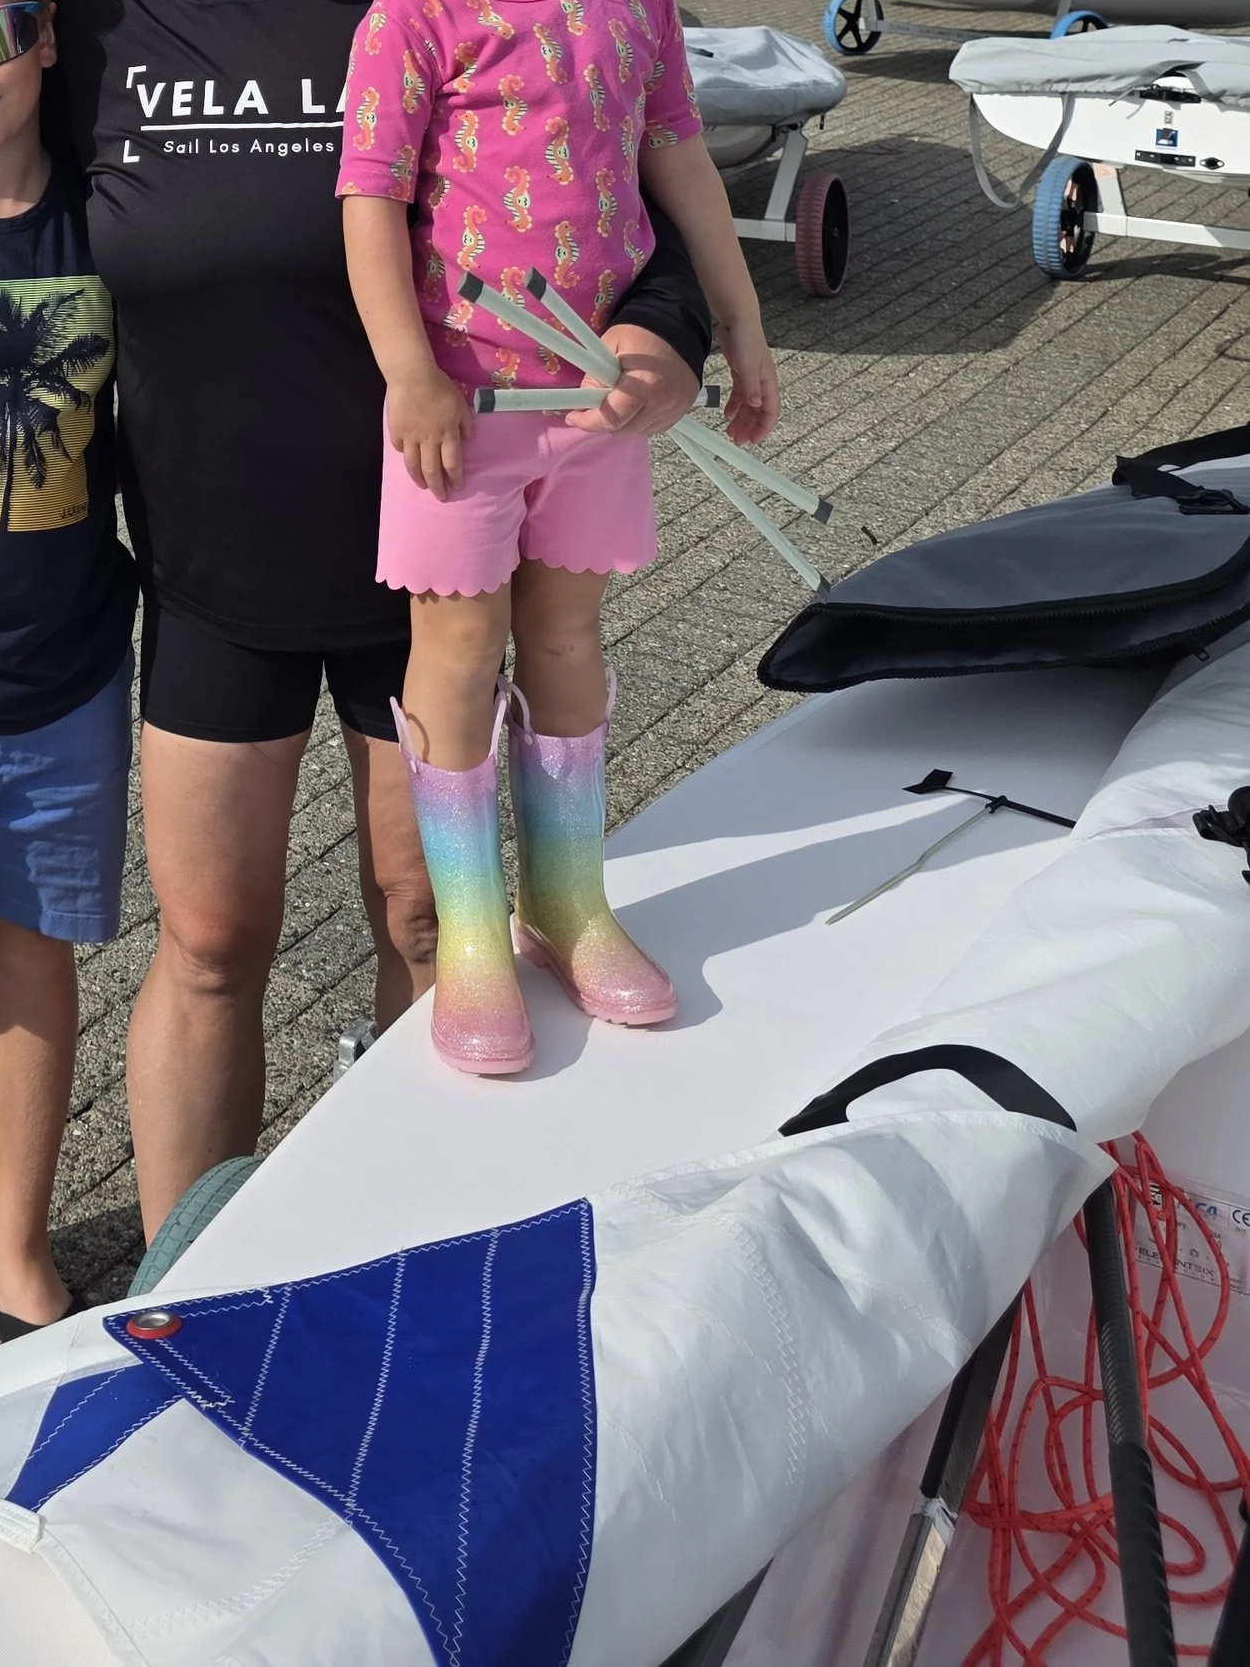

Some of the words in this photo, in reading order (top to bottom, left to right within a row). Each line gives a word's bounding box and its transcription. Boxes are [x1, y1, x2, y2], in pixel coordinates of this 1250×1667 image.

[136, 79, 269, 118] VELA
[163, 138, 199, 154] Sail
[209, 138, 240, 154] Los
[250, 138, 335, 157] Angeles
[1138, 1246, 1214, 1278] ELENTSIX
